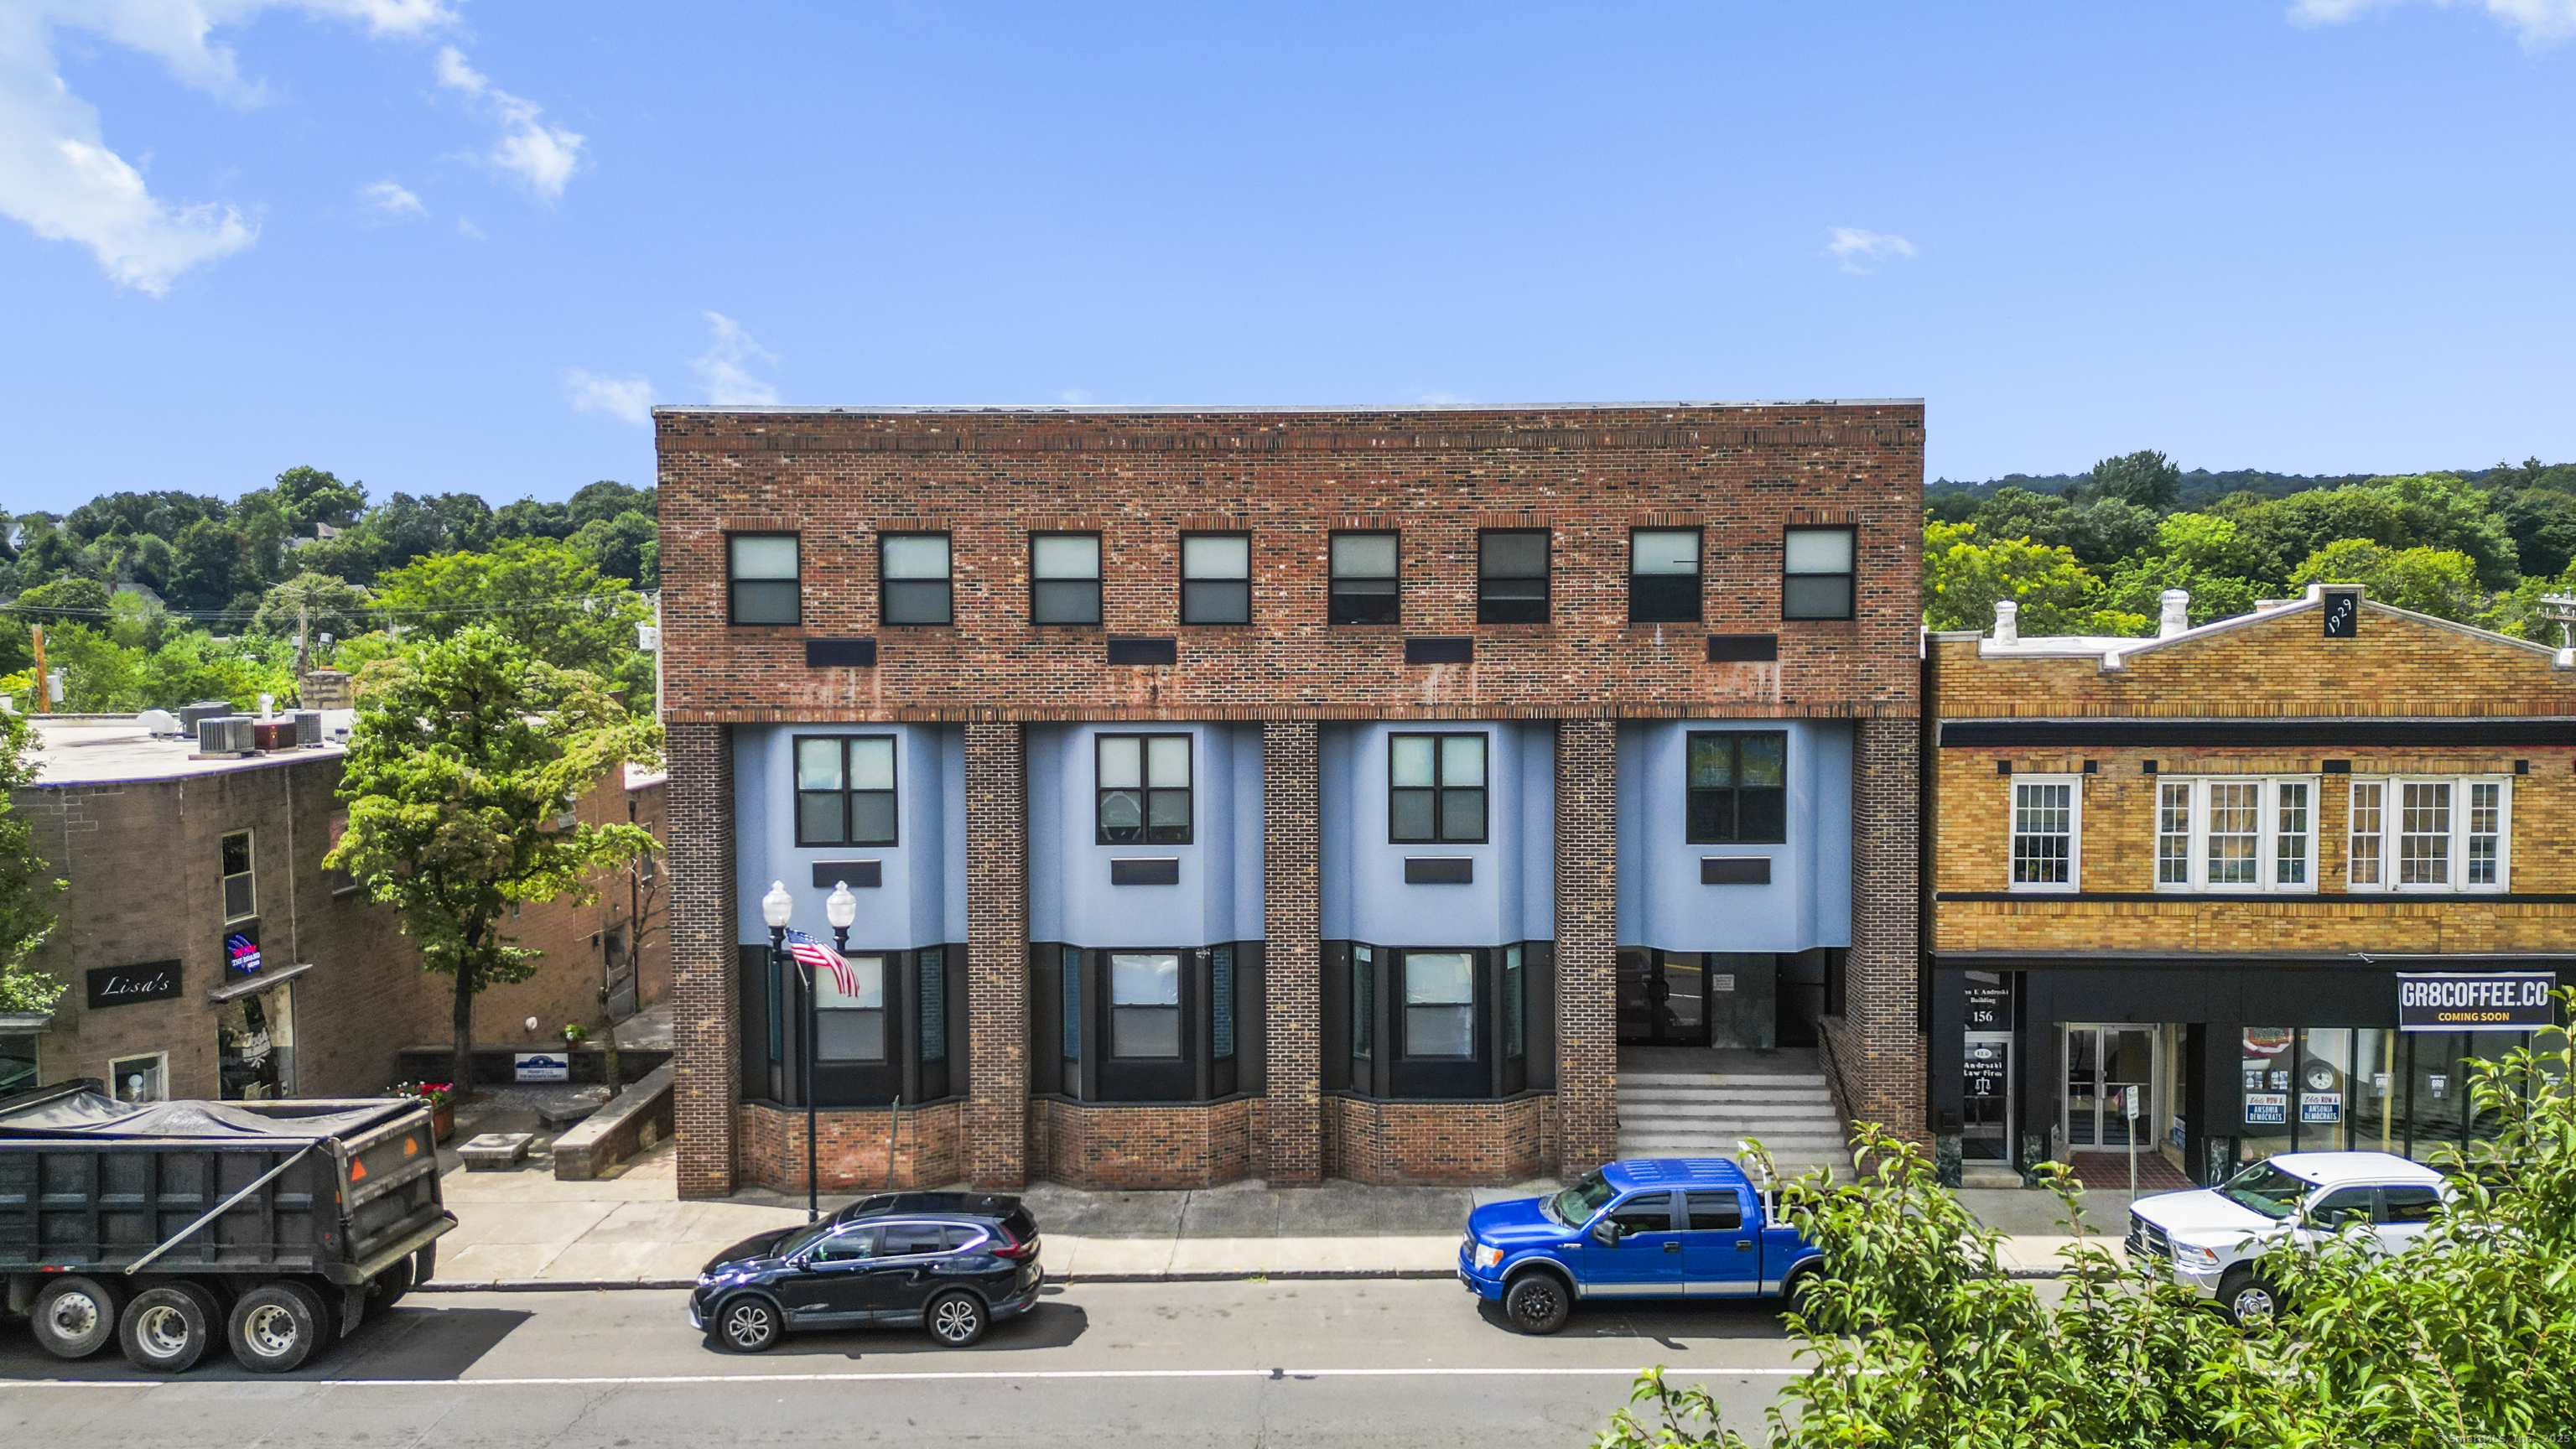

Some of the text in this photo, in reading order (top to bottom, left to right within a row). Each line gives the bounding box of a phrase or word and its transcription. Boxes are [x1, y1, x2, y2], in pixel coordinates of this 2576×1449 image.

[2328, 599, 2351, 633] 1929
[101, 972, 169, 995] Lisa's
[2402, 981, 2549, 1007] GR8COFFEE.CO
[1971, 996, 1997, 1005] Building
[1973, 1010, 1993, 1022] 156
[2438, 1012, 2510, 1021] COMING SOON
[2304, 1112, 2338, 1120] DEMOCRATS
